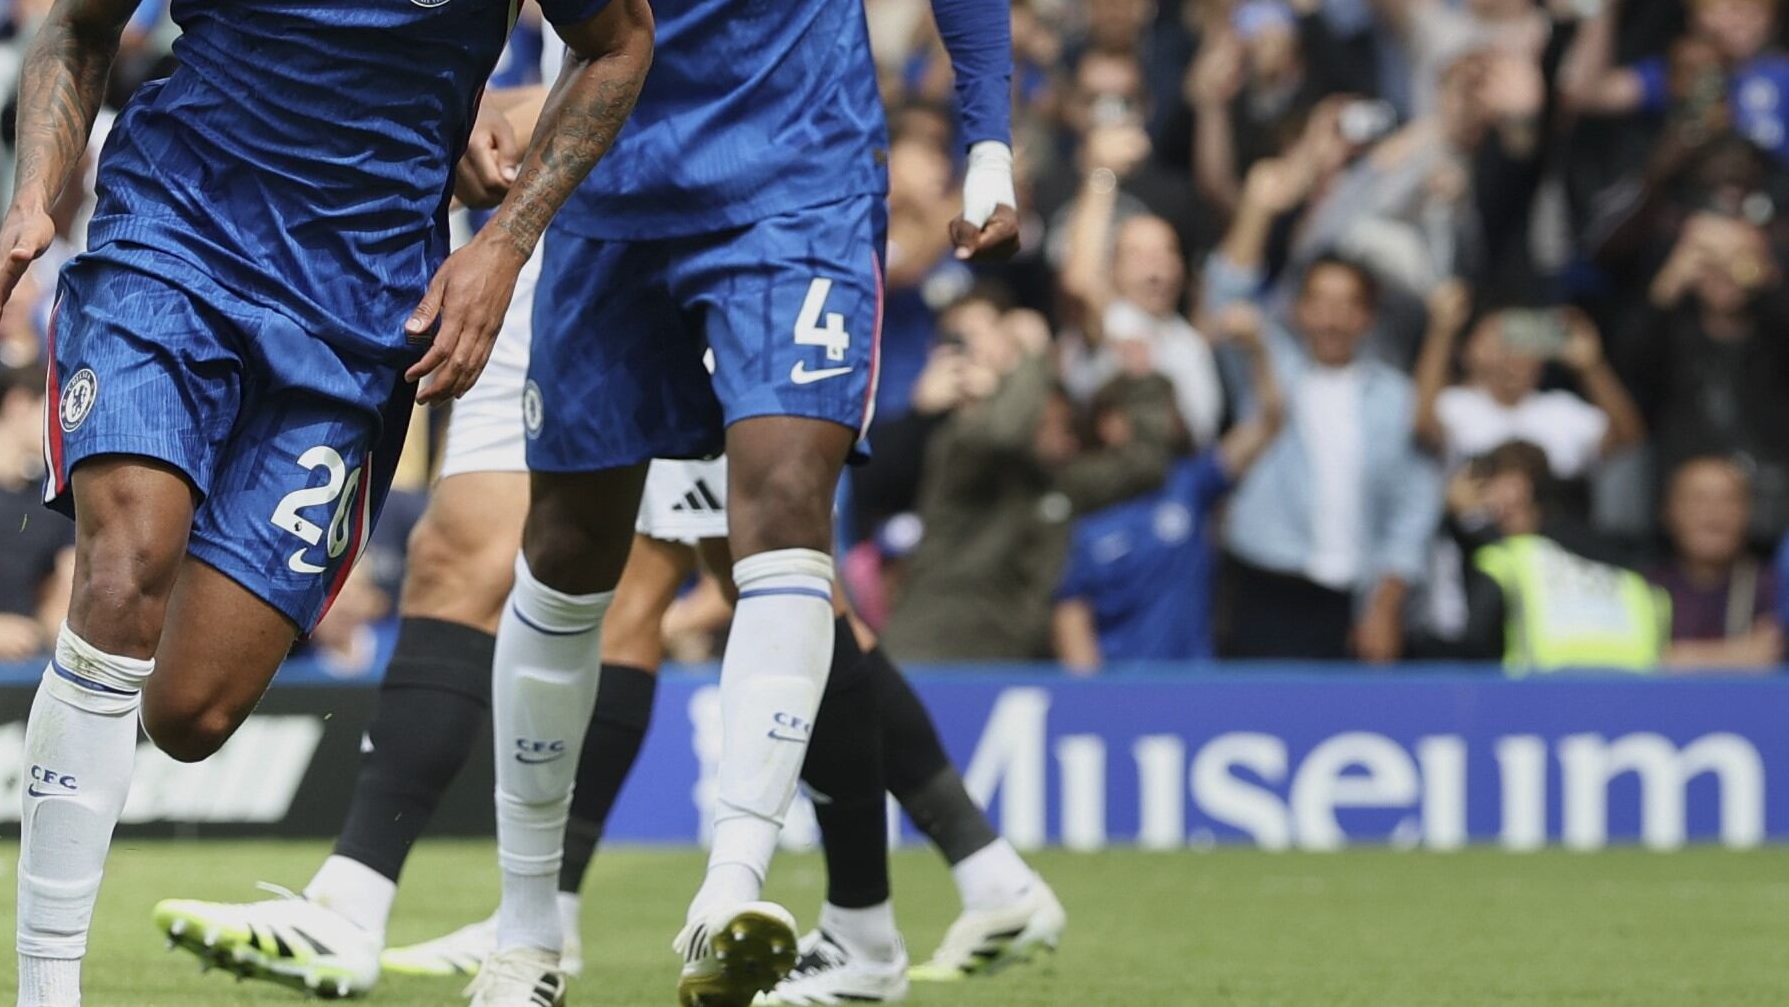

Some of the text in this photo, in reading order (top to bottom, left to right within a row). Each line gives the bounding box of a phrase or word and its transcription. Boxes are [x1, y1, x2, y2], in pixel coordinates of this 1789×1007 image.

[794, 278, 850, 362] 4
[271, 446, 362, 558] 20
[517, 738, 565, 752] CFC
[31, 765, 77, 790] CFC
